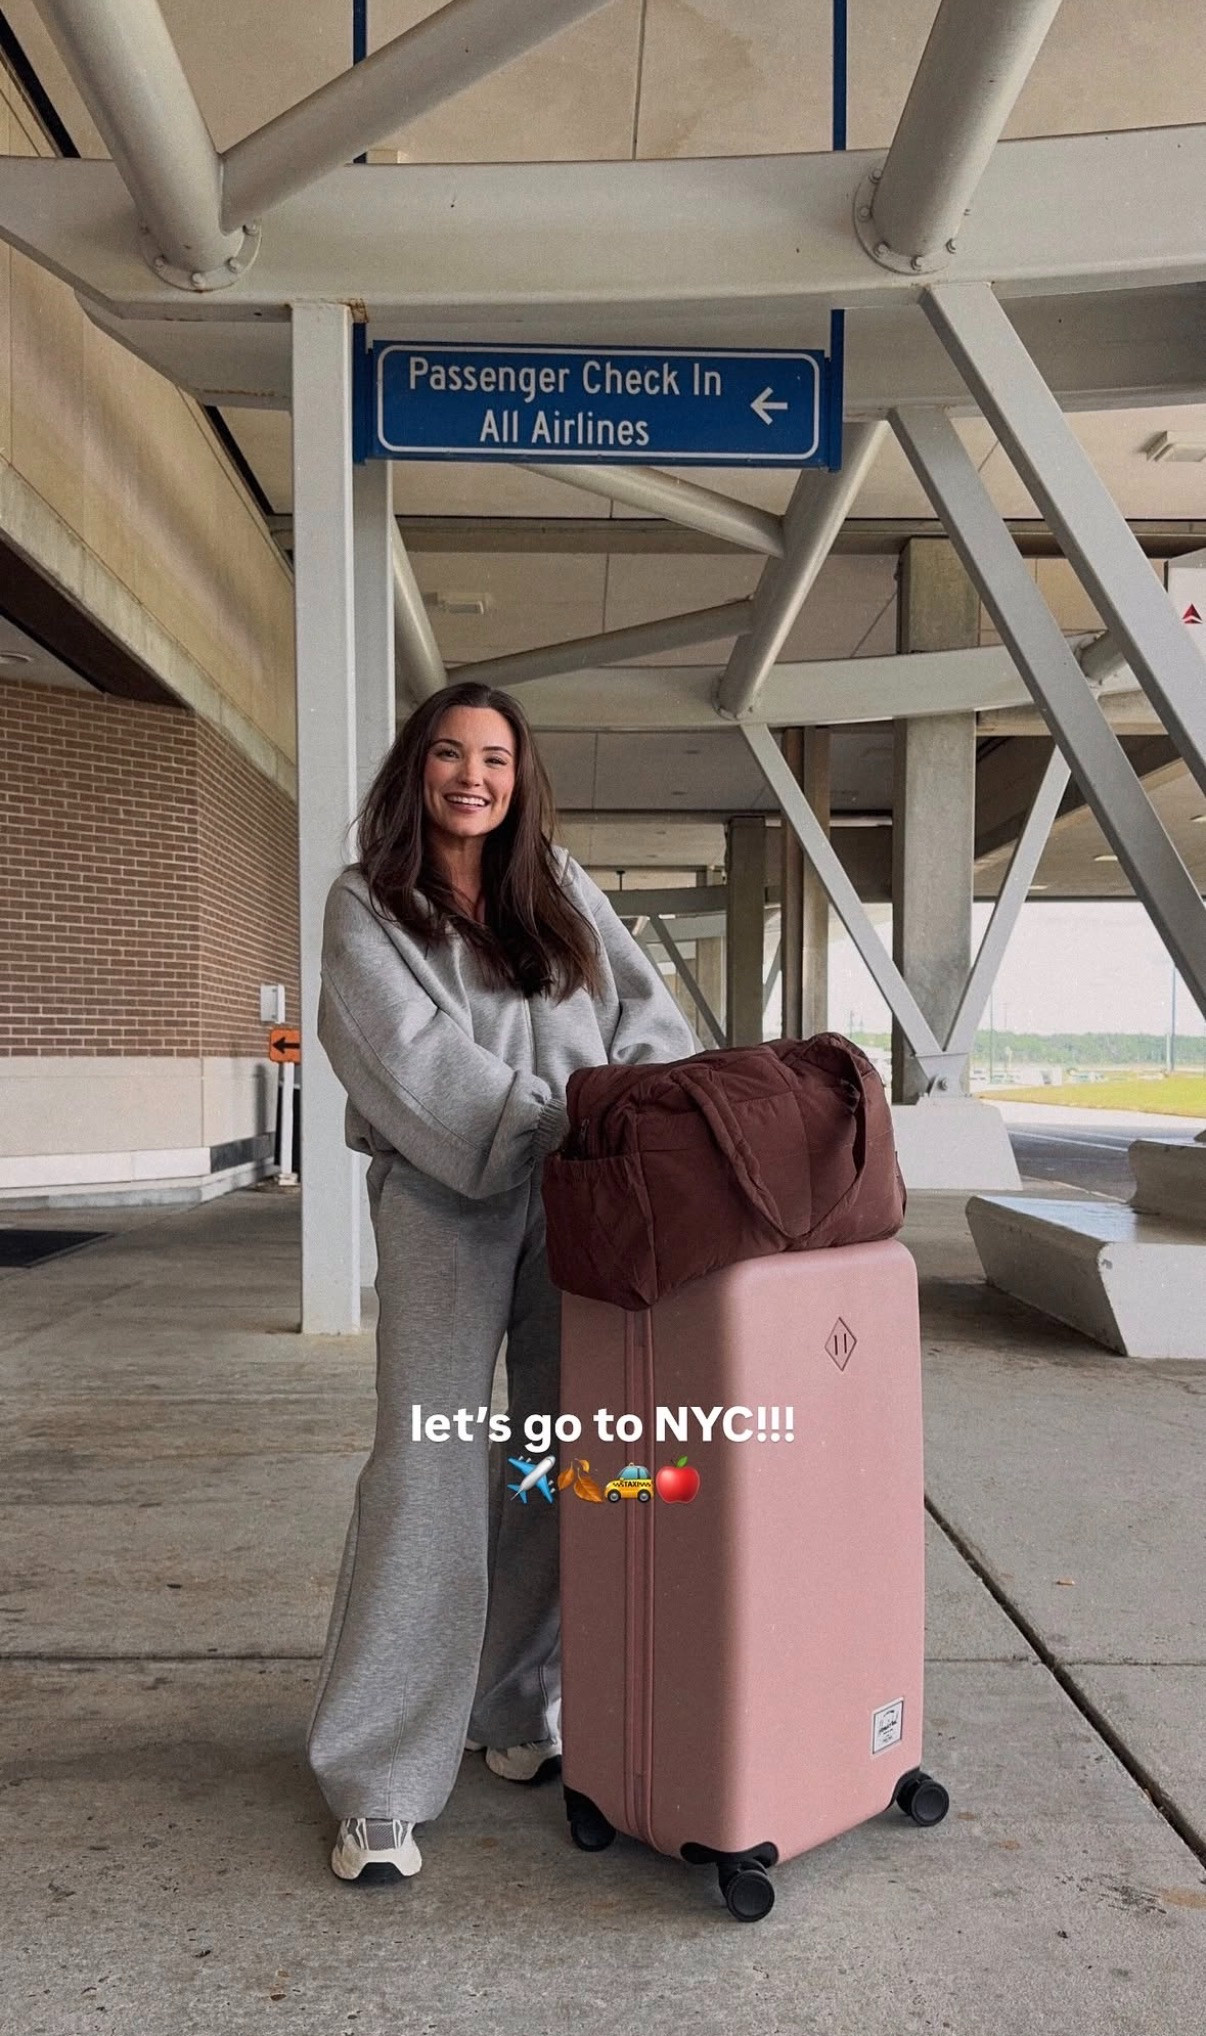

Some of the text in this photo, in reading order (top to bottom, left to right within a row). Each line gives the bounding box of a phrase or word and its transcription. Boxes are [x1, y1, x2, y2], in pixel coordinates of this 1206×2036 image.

[410, 357, 721, 403] Passenger Check In
[480, 410, 649, 446] All Airlines
